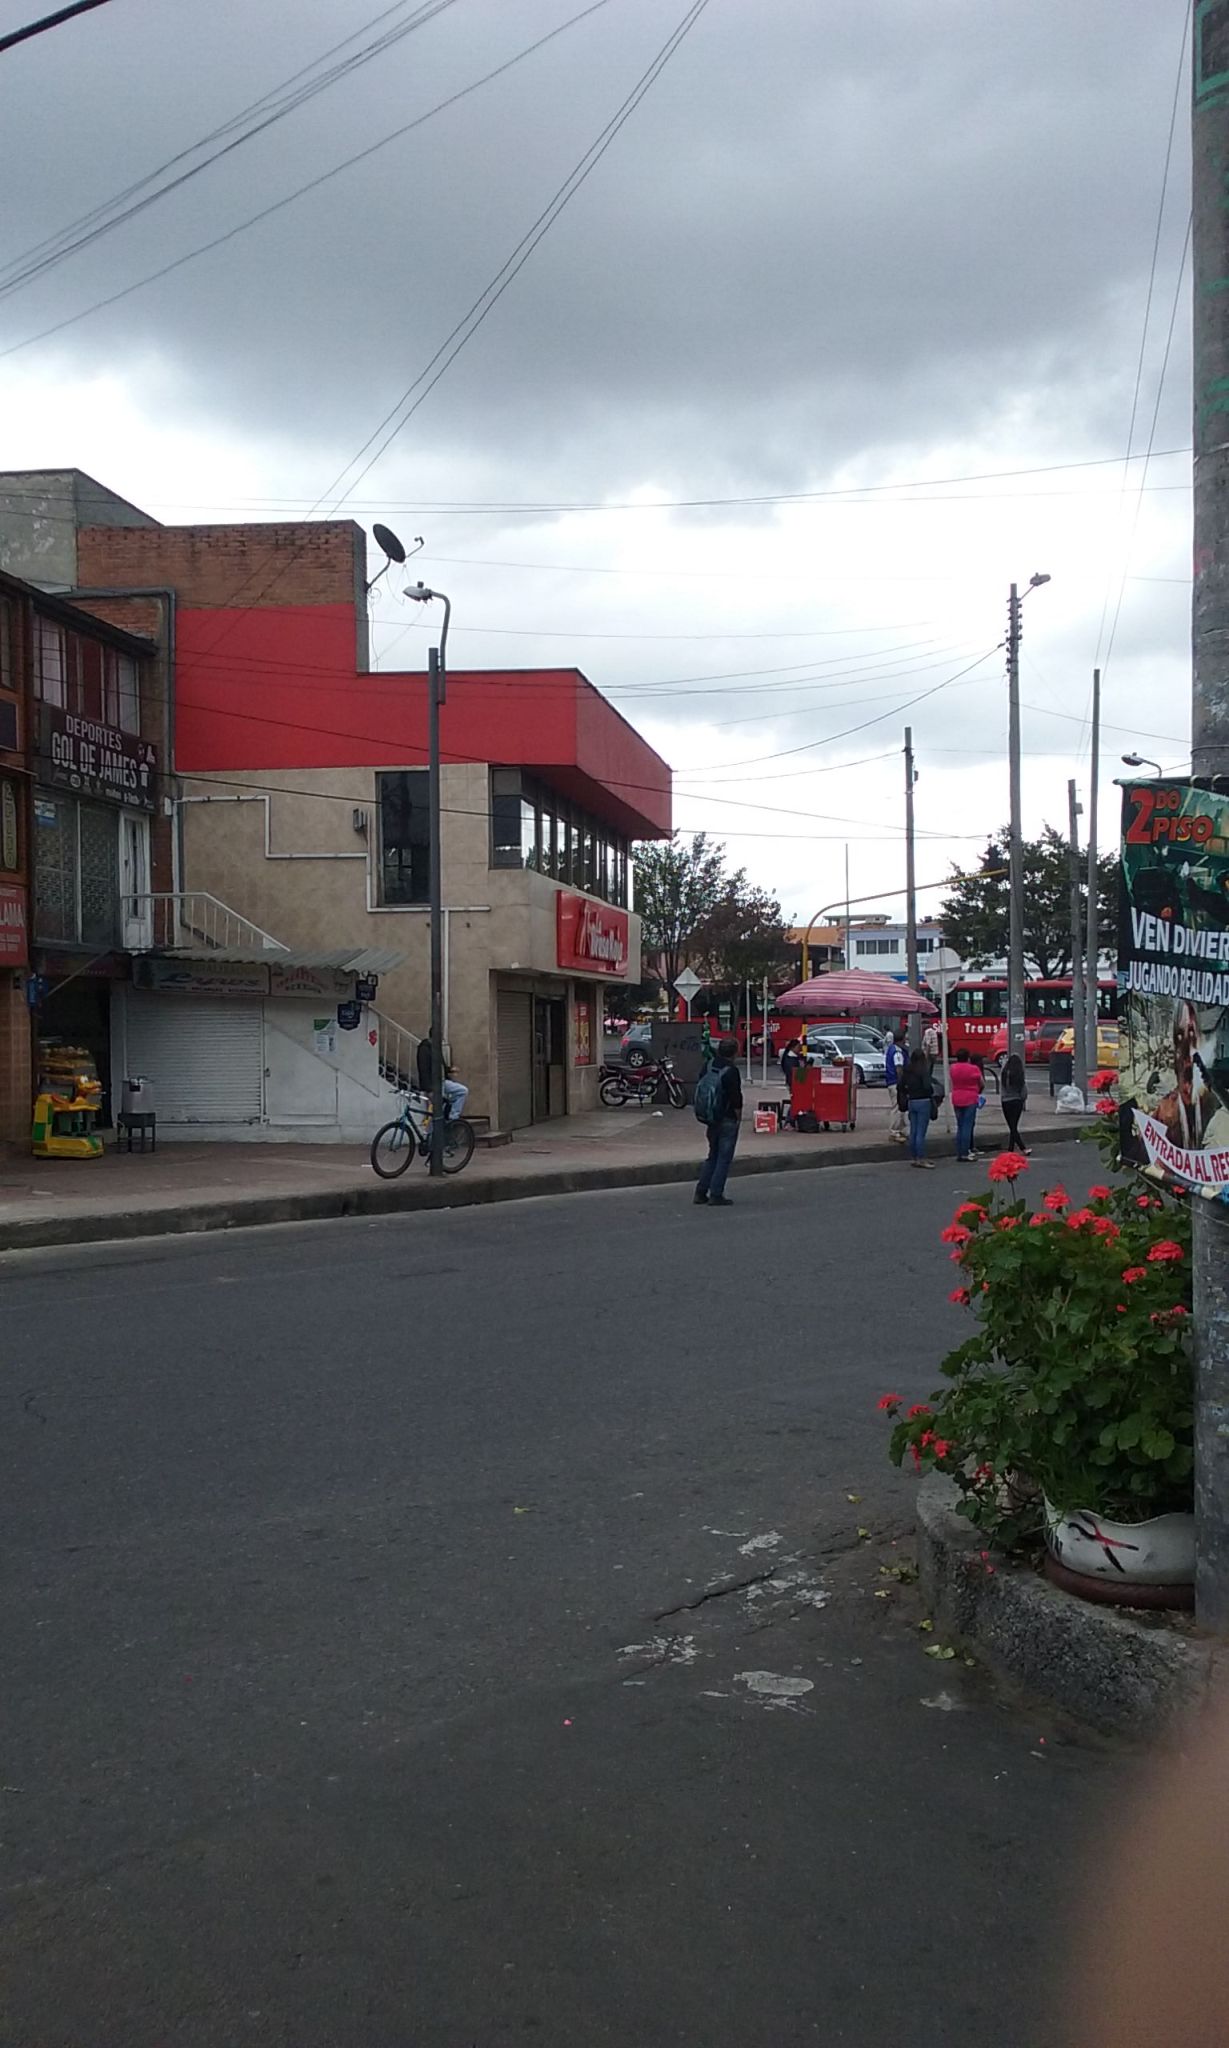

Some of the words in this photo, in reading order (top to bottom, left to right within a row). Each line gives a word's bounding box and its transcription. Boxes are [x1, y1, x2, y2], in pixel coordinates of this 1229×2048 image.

[66, 714, 122, 751] DEPORTES
[52, 732, 77, 771] GOL
[80, 741, 96, 777] DE
[99, 748, 137, 789] JAMES
[1153, 815, 1214, 843] PISO
[1130, 907, 1170, 951] VEN
[1126, 961, 1178, 997] JUGANDO
[1145, 1120, 1192, 1178] ENTRADA
[1195, 1155, 1212, 1182] AL
